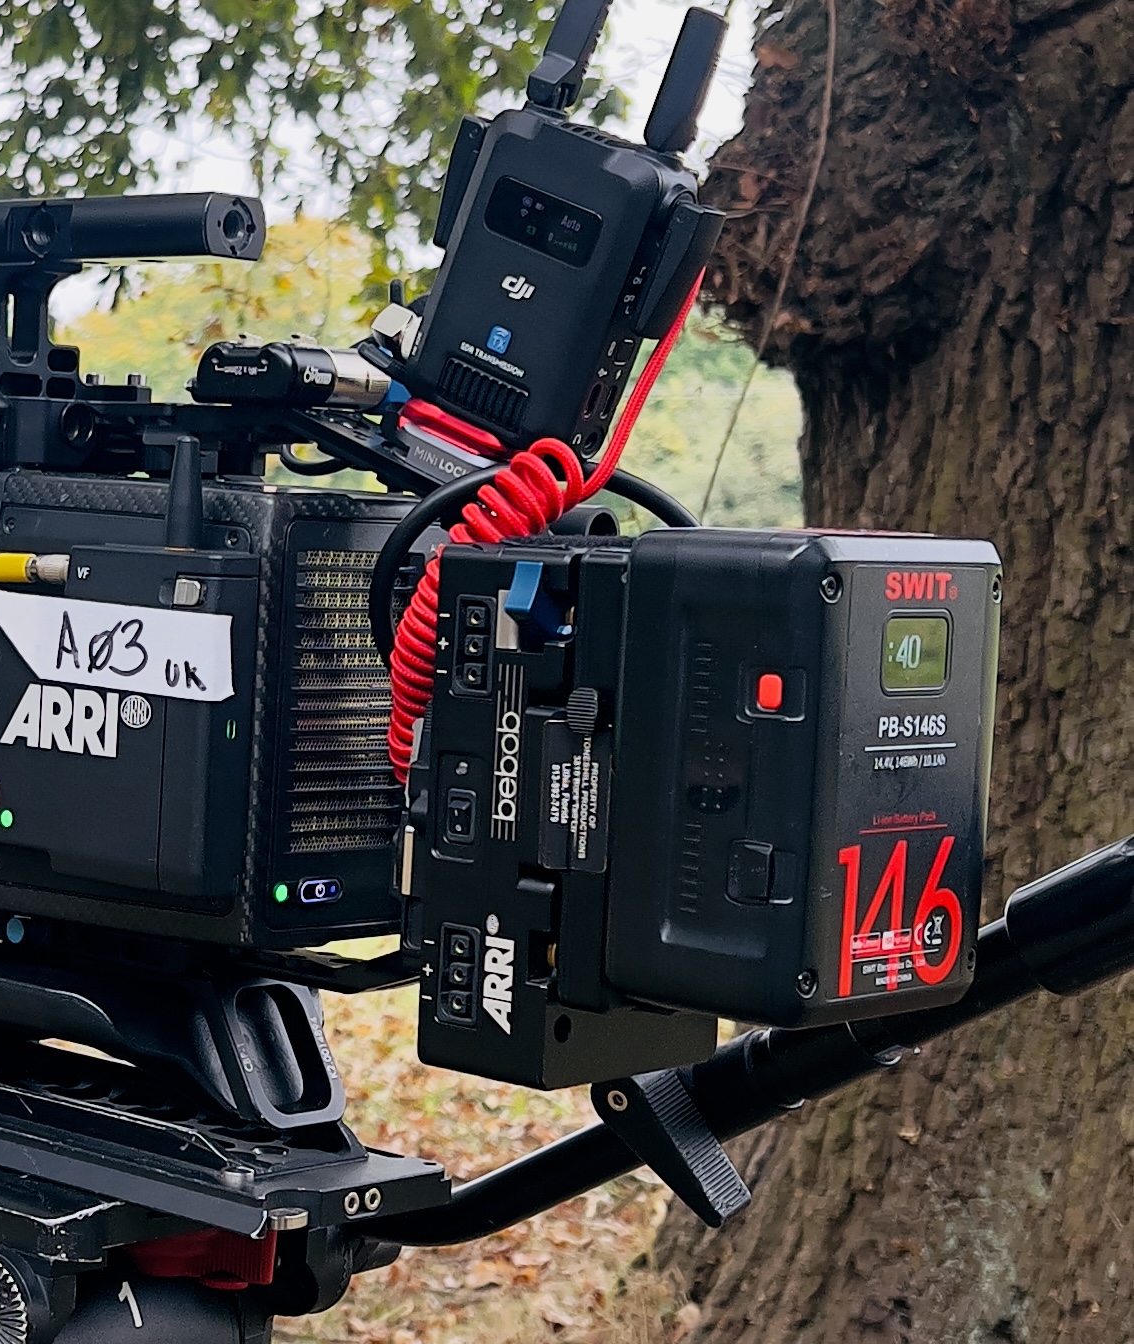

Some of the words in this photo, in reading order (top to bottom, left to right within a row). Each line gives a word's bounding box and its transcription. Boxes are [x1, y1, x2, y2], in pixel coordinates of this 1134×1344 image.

[414, 446, 438, 467] MINI
[77, 566, 90, 580] VF
[884, 572, 953, 600] SWIT
[165, 659, 207, 691] UK
[0, 683, 119, 758] ARRI
[878, 714, 947, 739] PB-S146S
[492, 711, 521, 822] bebob
[838, 836, 962, 997] 146
[482, 936, 515, 1035] ARRI
[118, 1281, 143, 1328] 1
